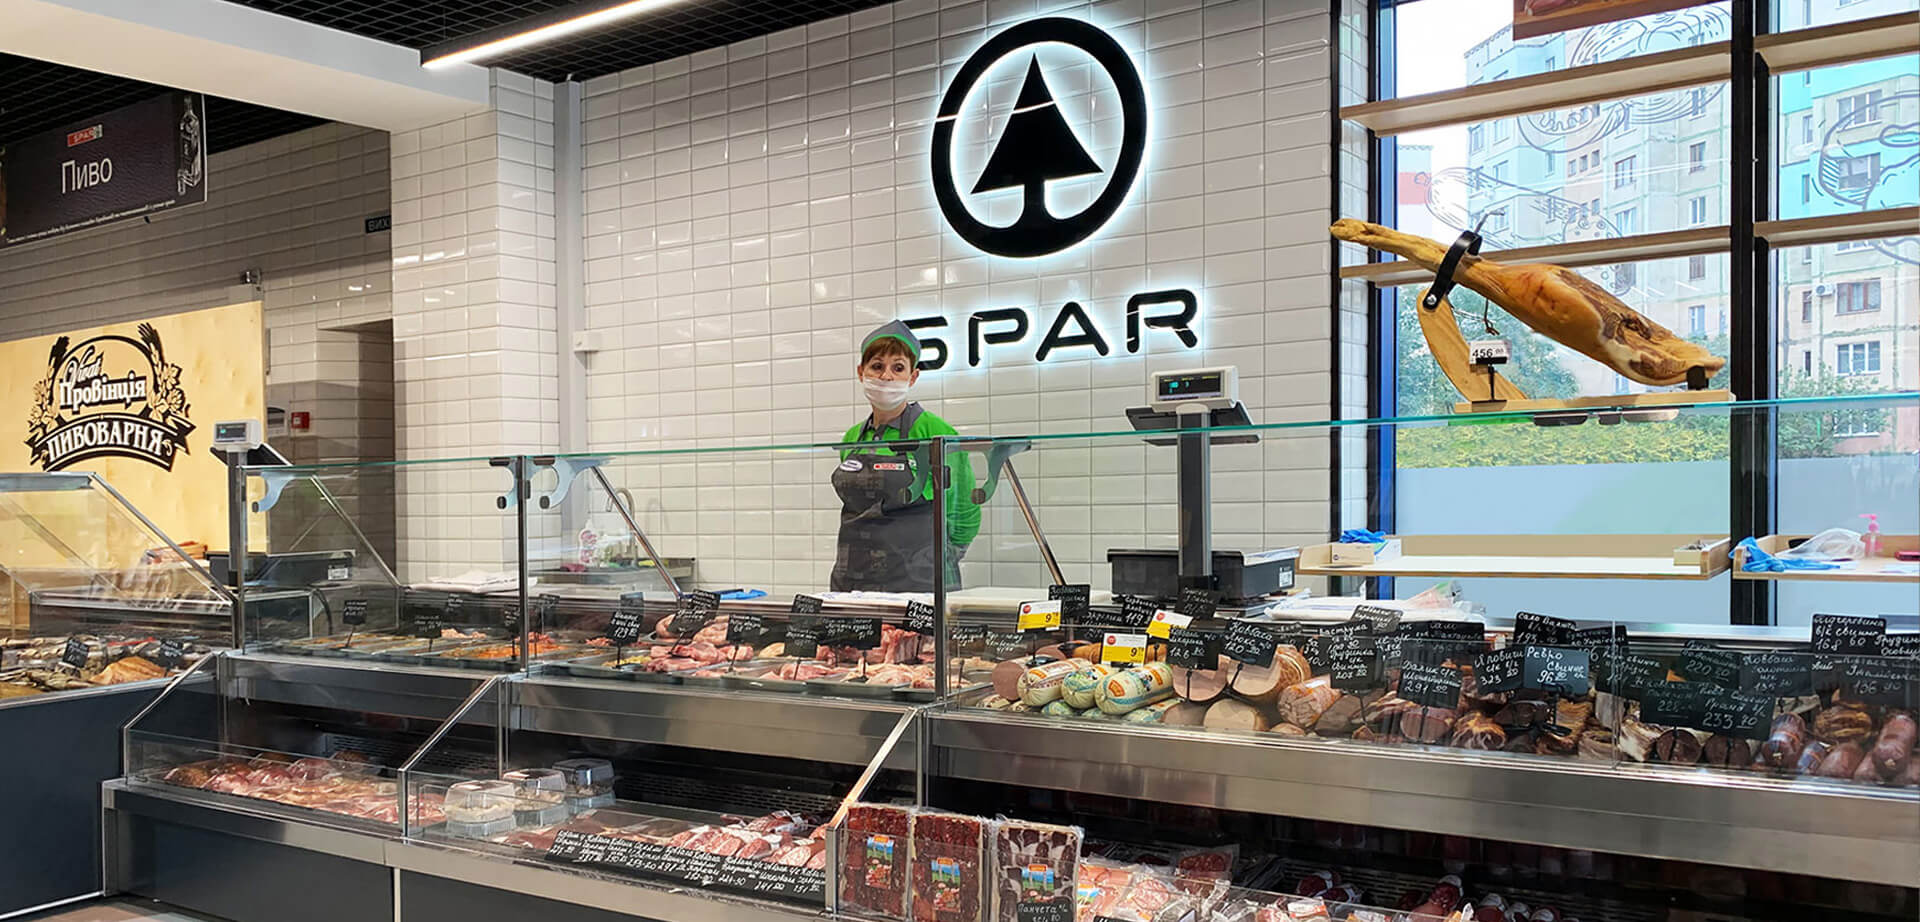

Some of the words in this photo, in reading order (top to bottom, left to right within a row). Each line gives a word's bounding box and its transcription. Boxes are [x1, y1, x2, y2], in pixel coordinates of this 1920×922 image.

[62, 158, 112, 193] Пиво
[901, 288, 1198, 371] SPAR
[1473, 348, 1493, 358] 456
[46, 421, 165, 463] ПИВОВАРНЯ
[1045, 613, 1052, 623] 9
[1130, 647, 1137, 657] 9
[1526, 645, 1564, 663] Ребро
[1537, 669, 1555, 684] 96
[1702, 711, 1734, 730] 233
